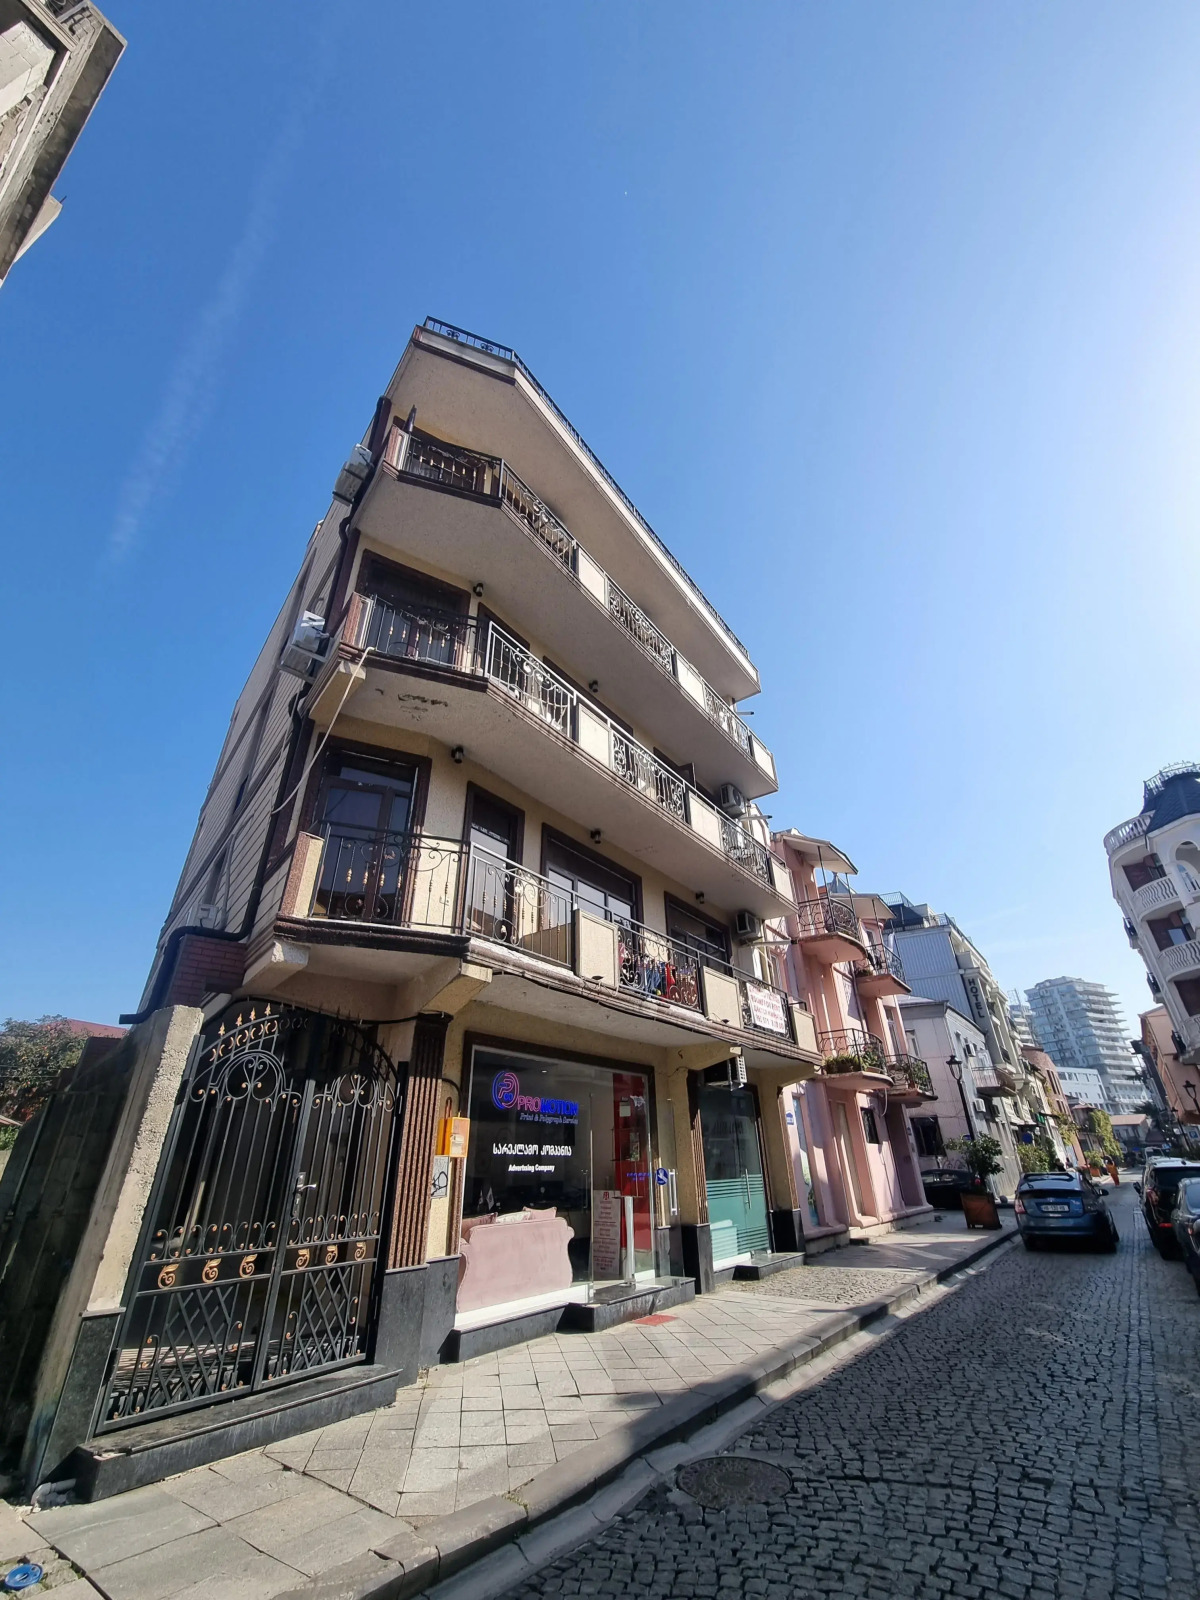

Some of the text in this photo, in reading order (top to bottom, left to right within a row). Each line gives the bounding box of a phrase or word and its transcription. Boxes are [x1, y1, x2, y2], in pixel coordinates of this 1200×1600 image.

[967, 978, 985, 1018] HOTEL
[517, 1096, 578, 1116] PROMOTION
[493, 1143, 572, 1156] სარეკლამო კომპანია
[508, 1164, 555, 1172] Advertising Company
